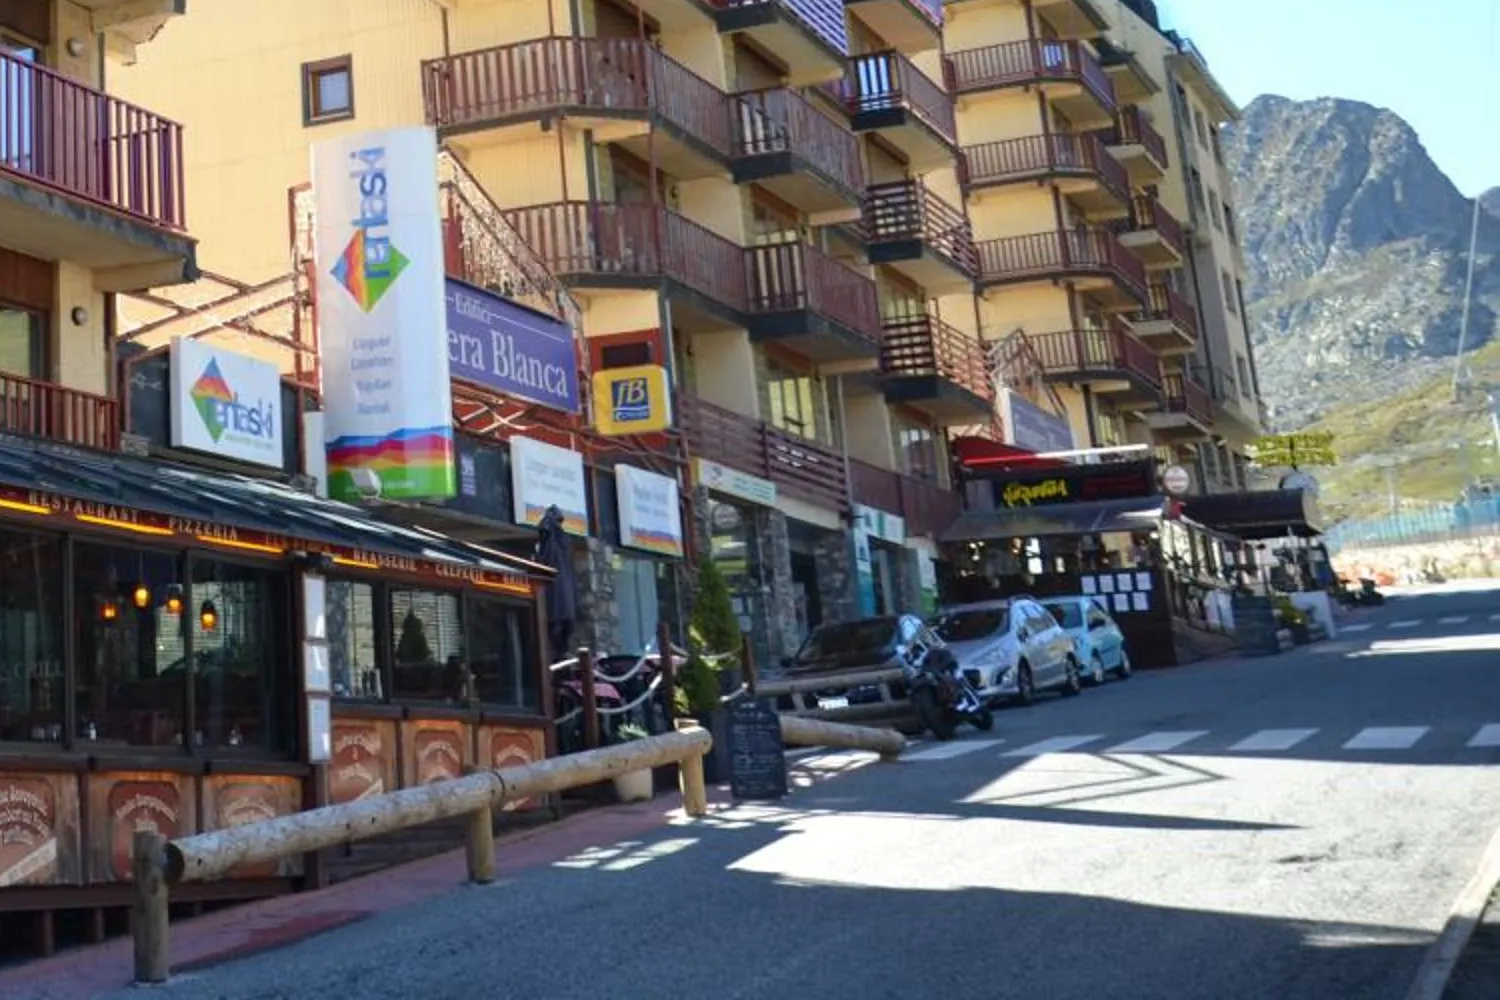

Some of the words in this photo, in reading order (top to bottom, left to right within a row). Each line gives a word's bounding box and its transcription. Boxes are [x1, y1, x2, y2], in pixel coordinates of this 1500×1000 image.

[490, 329, 569, 399] Blanca
[27, 490, 139, 524] RESTAURANT
[169, 517, 239, 541] PIZZERIA
